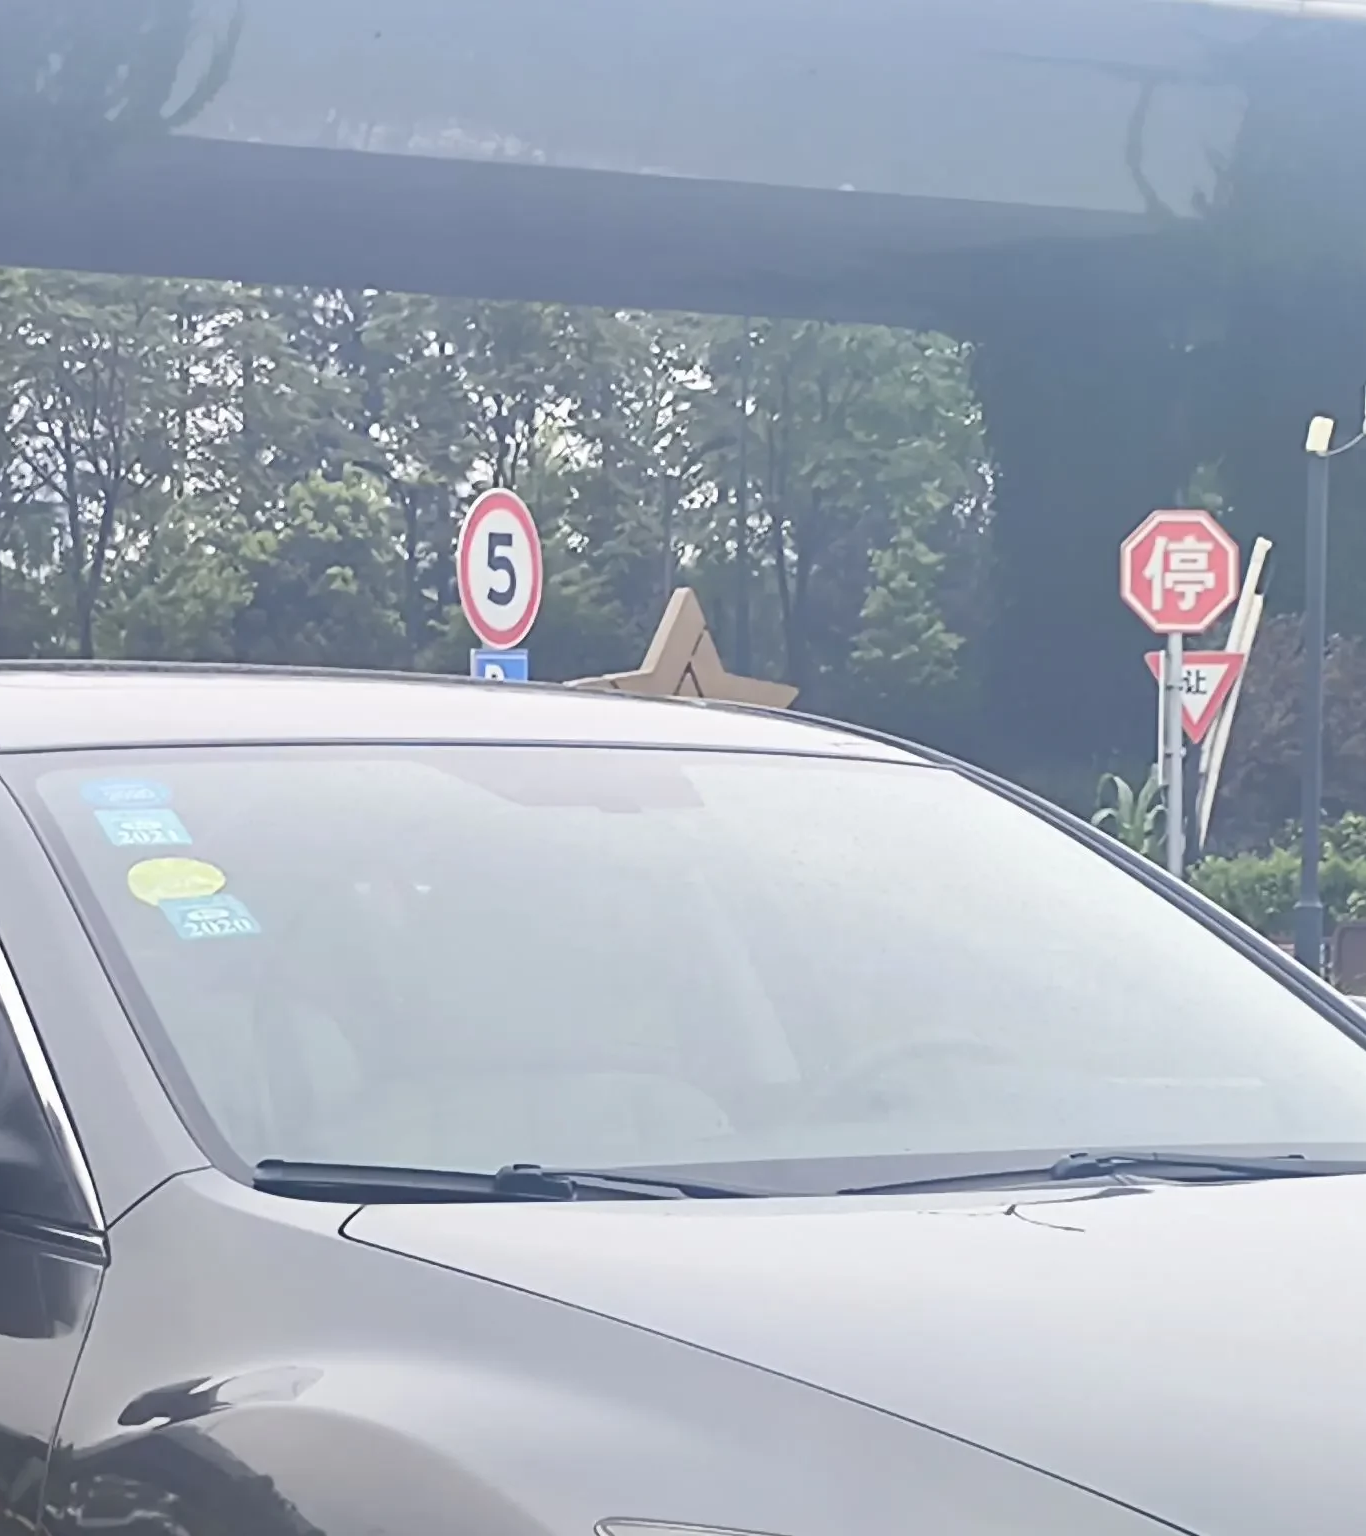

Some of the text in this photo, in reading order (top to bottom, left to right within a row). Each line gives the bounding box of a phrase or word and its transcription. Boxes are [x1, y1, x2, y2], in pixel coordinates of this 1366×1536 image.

[487, 532, 517, 606] 5
[1143, 535, 1216, 611] 停
[1182, 669, 1207, 695] 让
